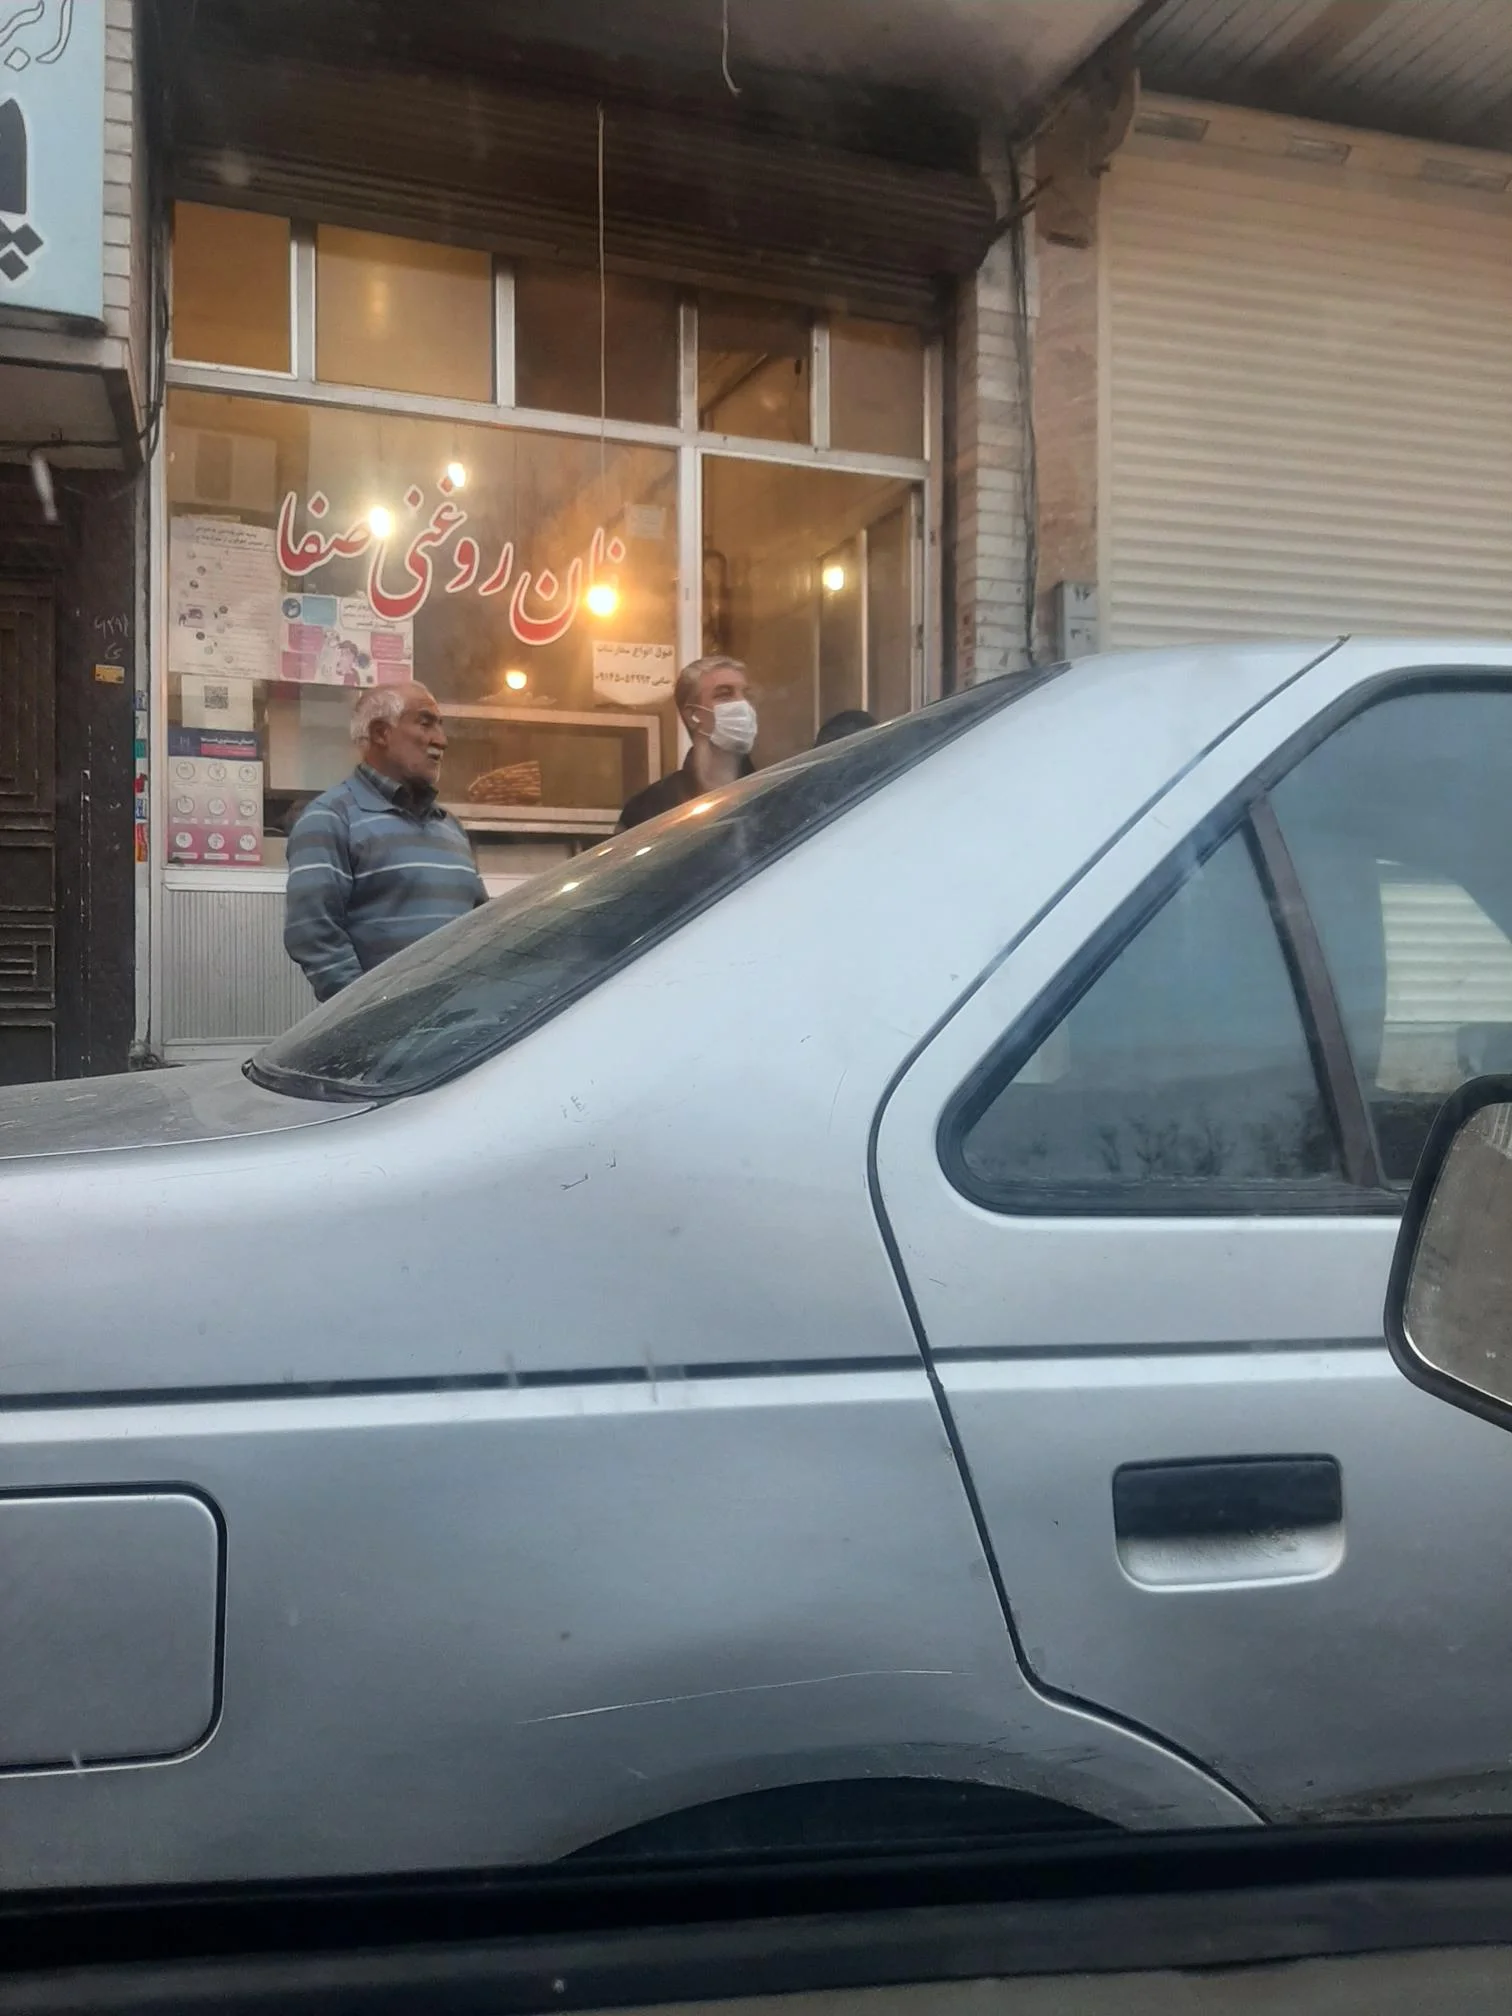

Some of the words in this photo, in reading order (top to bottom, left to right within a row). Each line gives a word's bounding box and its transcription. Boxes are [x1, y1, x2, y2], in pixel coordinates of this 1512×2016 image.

[276, 490, 376, 577] صفا
[366, 473, 514, 622] روغنی
[509, 526, 627, 646] نان
